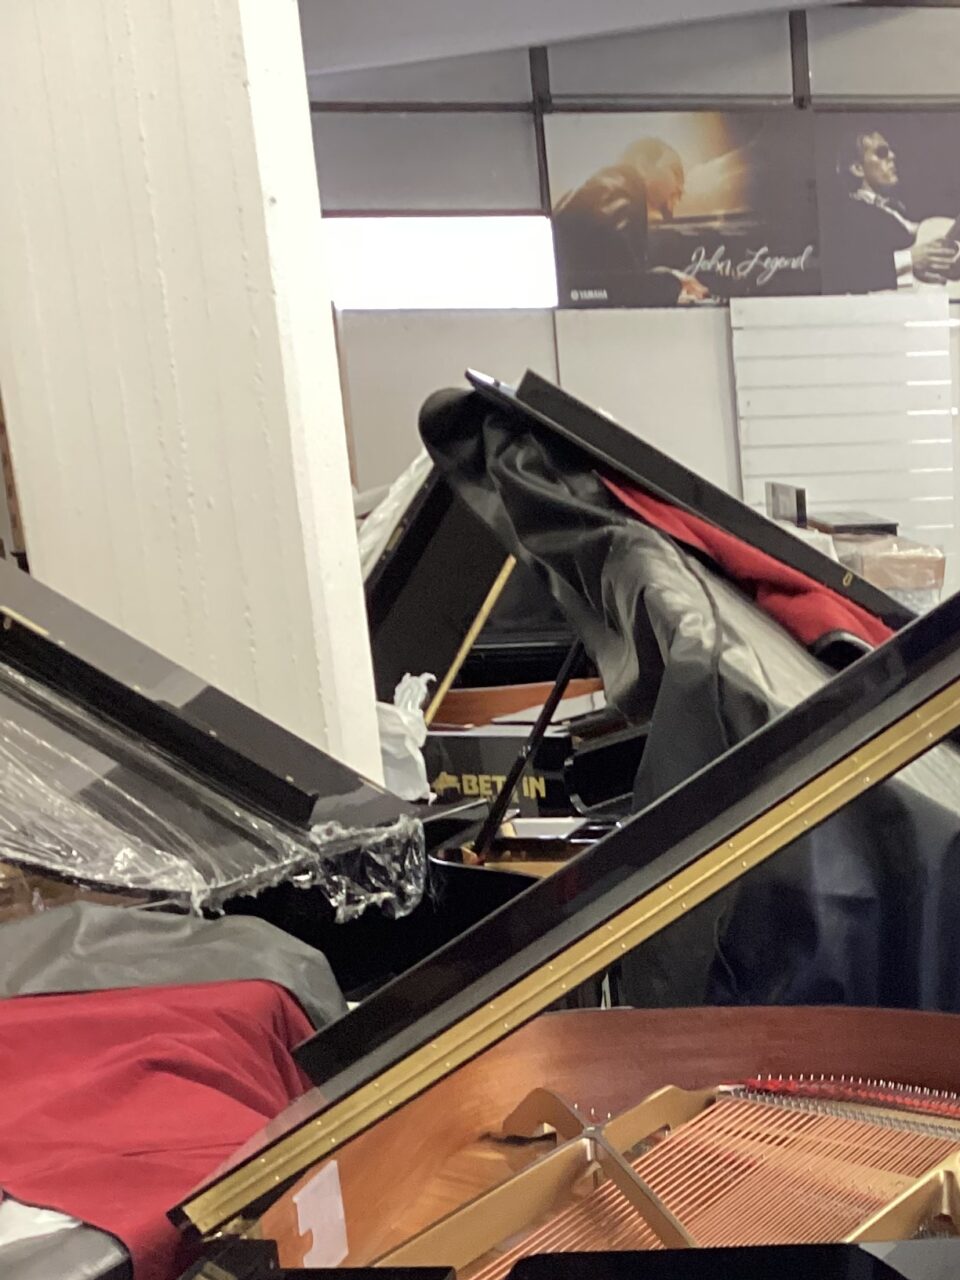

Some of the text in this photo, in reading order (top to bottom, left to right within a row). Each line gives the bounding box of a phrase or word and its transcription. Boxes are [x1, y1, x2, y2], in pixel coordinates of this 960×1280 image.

[684, 245, 813, 286] John Legend
[579, 289, 608, 300] YAMAHA
[462, 774, 546, 800] BETIN
